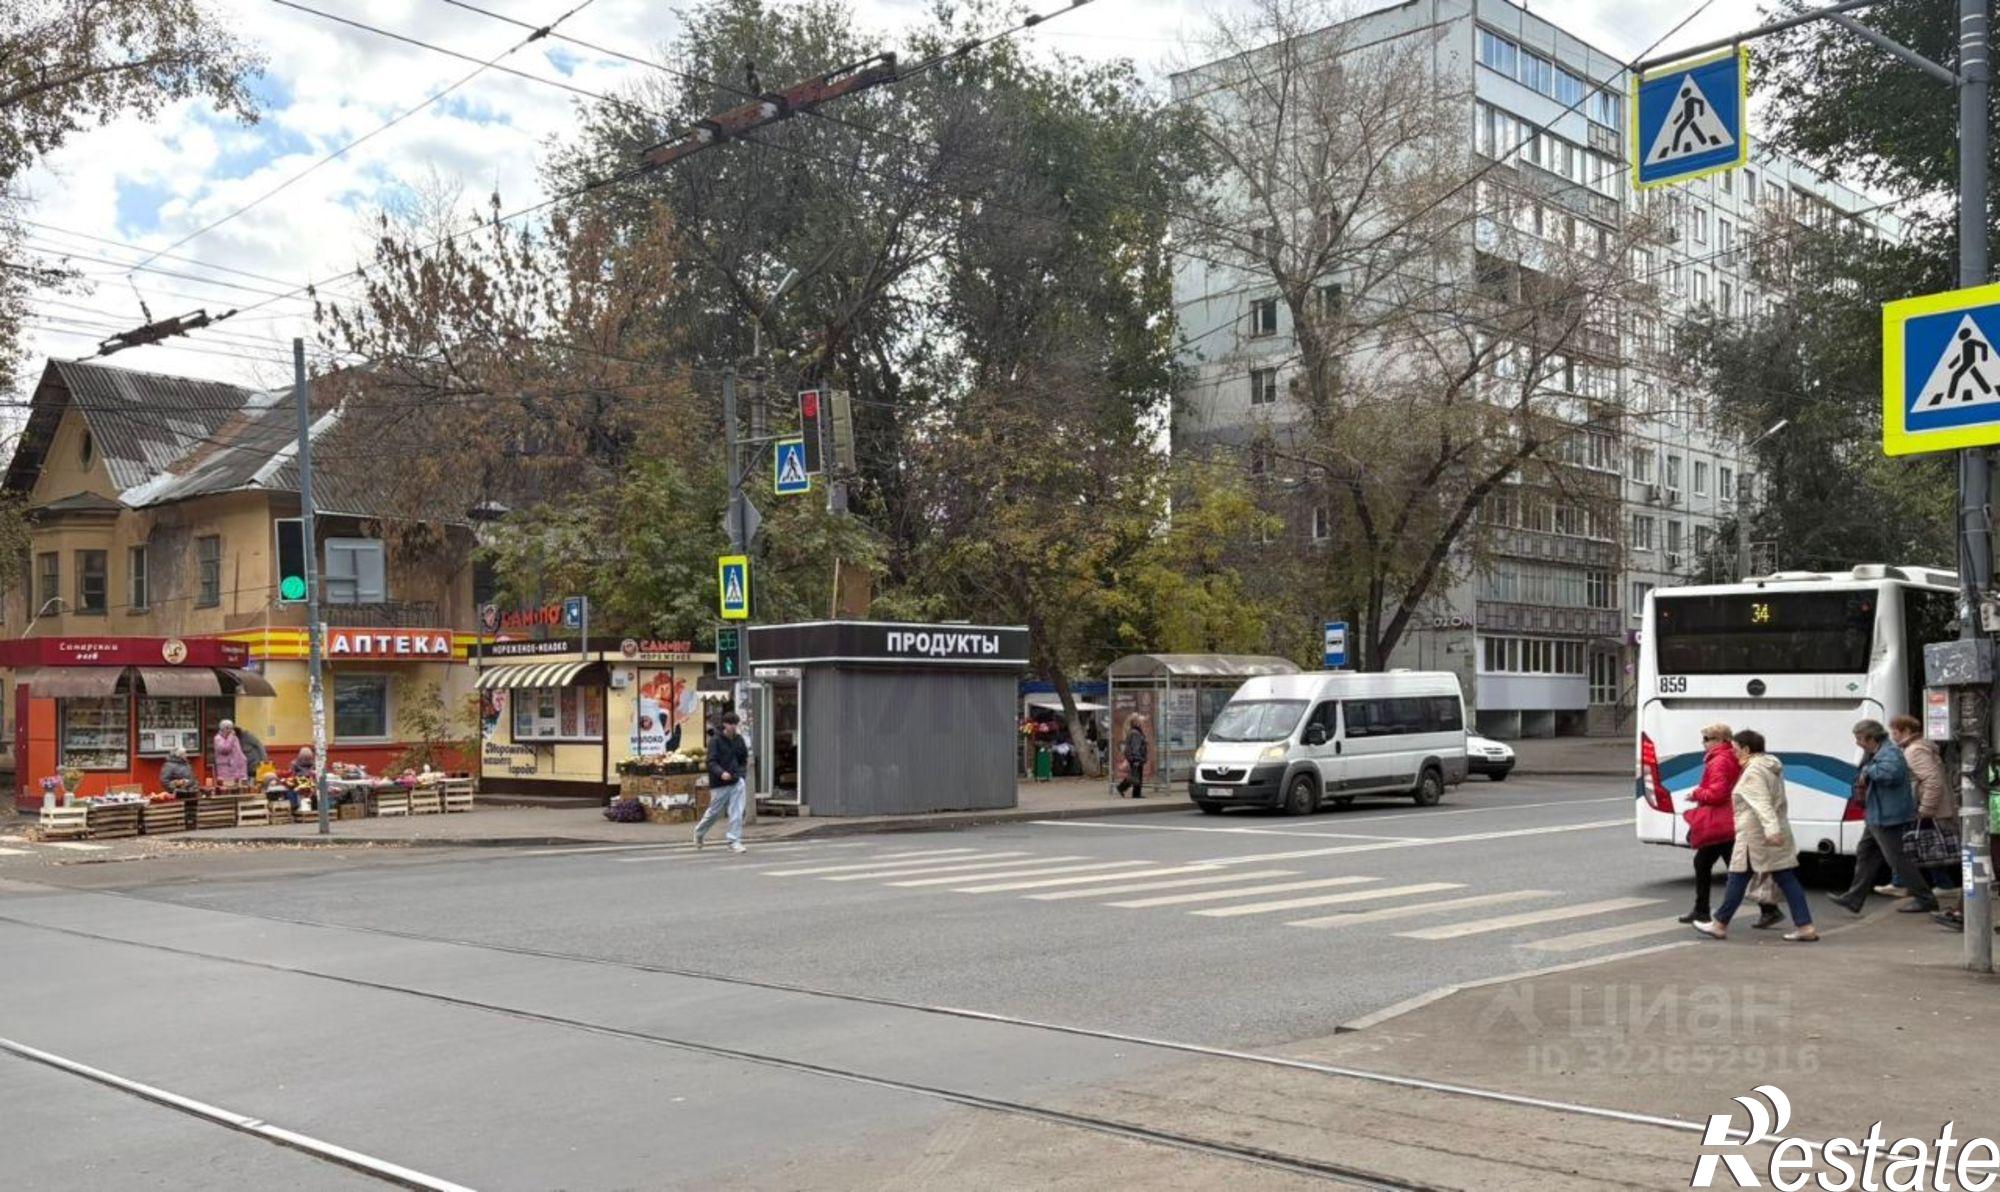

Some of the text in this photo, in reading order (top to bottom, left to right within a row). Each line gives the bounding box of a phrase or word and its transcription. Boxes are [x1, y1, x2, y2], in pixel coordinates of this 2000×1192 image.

[1751, 603, 1769, 623] 34
[332, 634, 449, 653] АПТЕКА
[887, 632, 999, 656] ПРОДУКТЫ
[1660, 677, 1687, 693] 859
